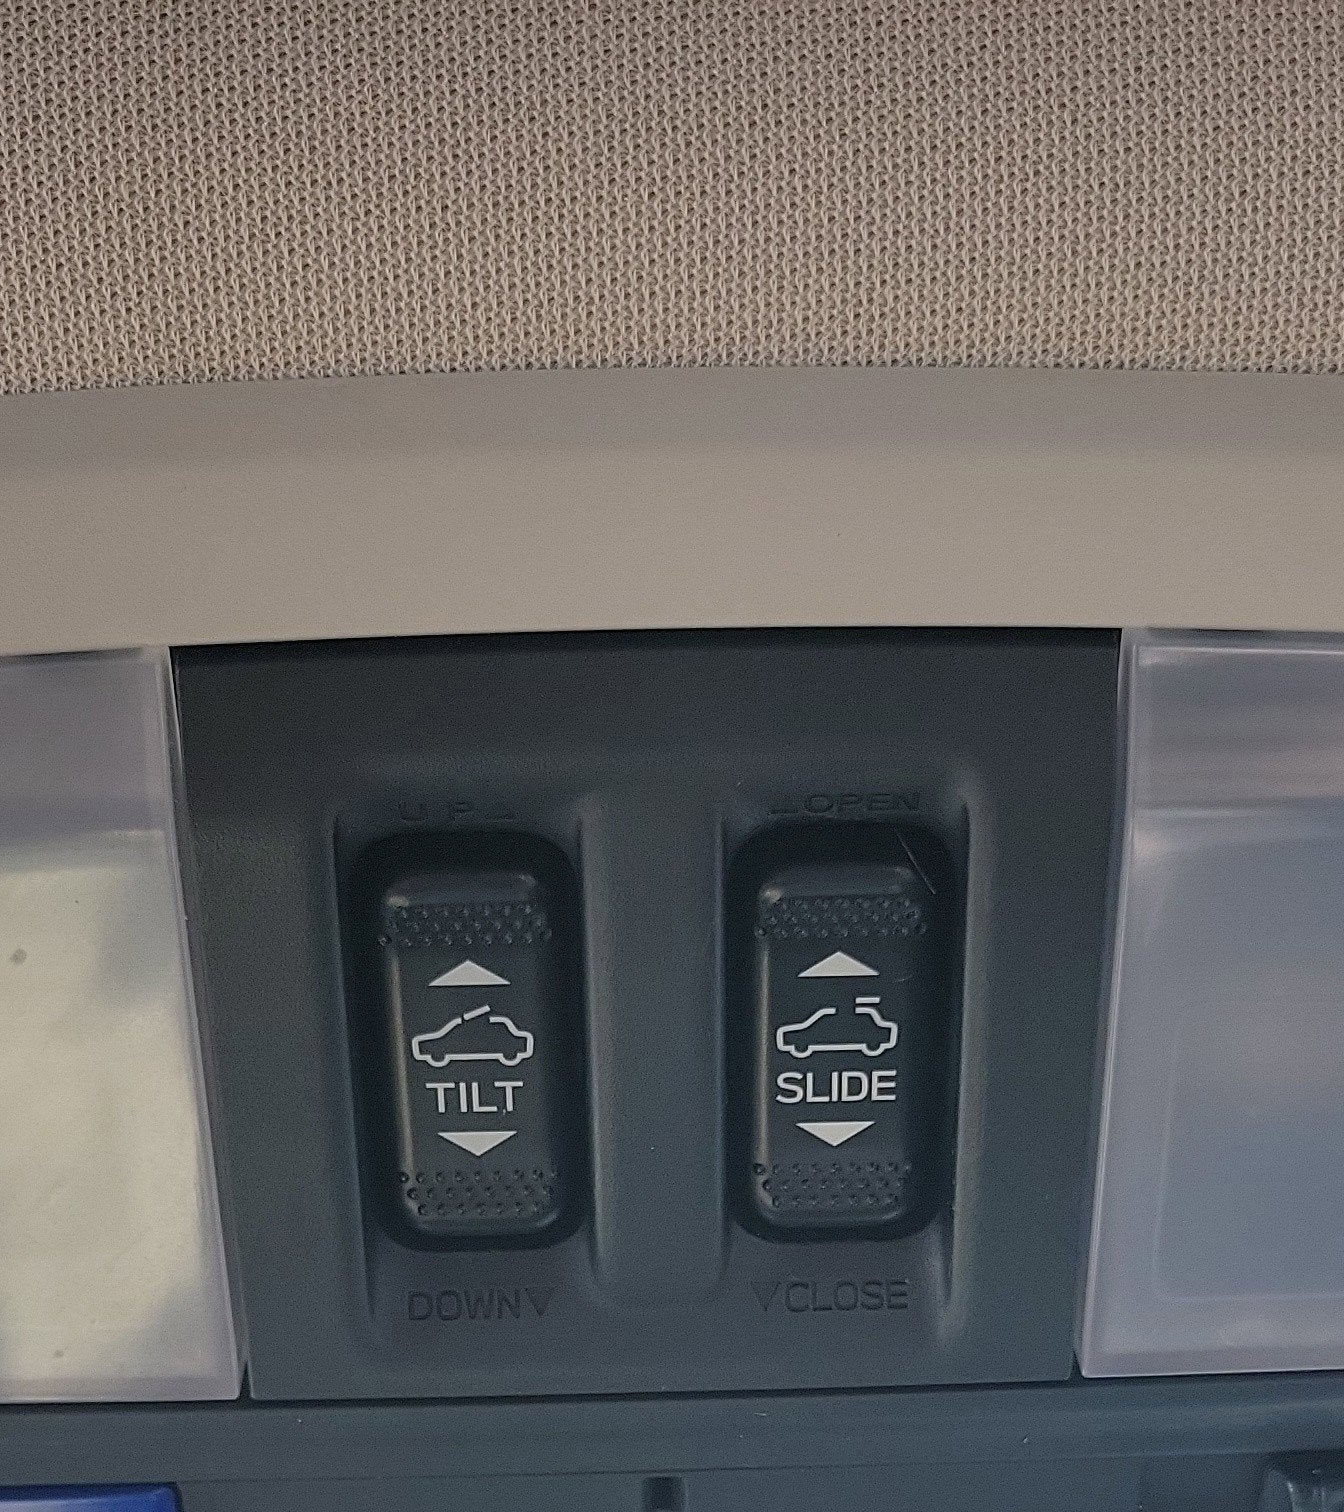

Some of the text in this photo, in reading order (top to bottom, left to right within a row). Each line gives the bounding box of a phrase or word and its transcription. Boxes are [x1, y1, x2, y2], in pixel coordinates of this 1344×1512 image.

[803, 793, 920, 815] OPEN
[425, 1080, 524, 1114] TILT
[775, 1070, 897, 1104] SLIDE
[407, 1288, 520, 1321] DOWN
[784, 1280, 910, 1312] CLOSE
